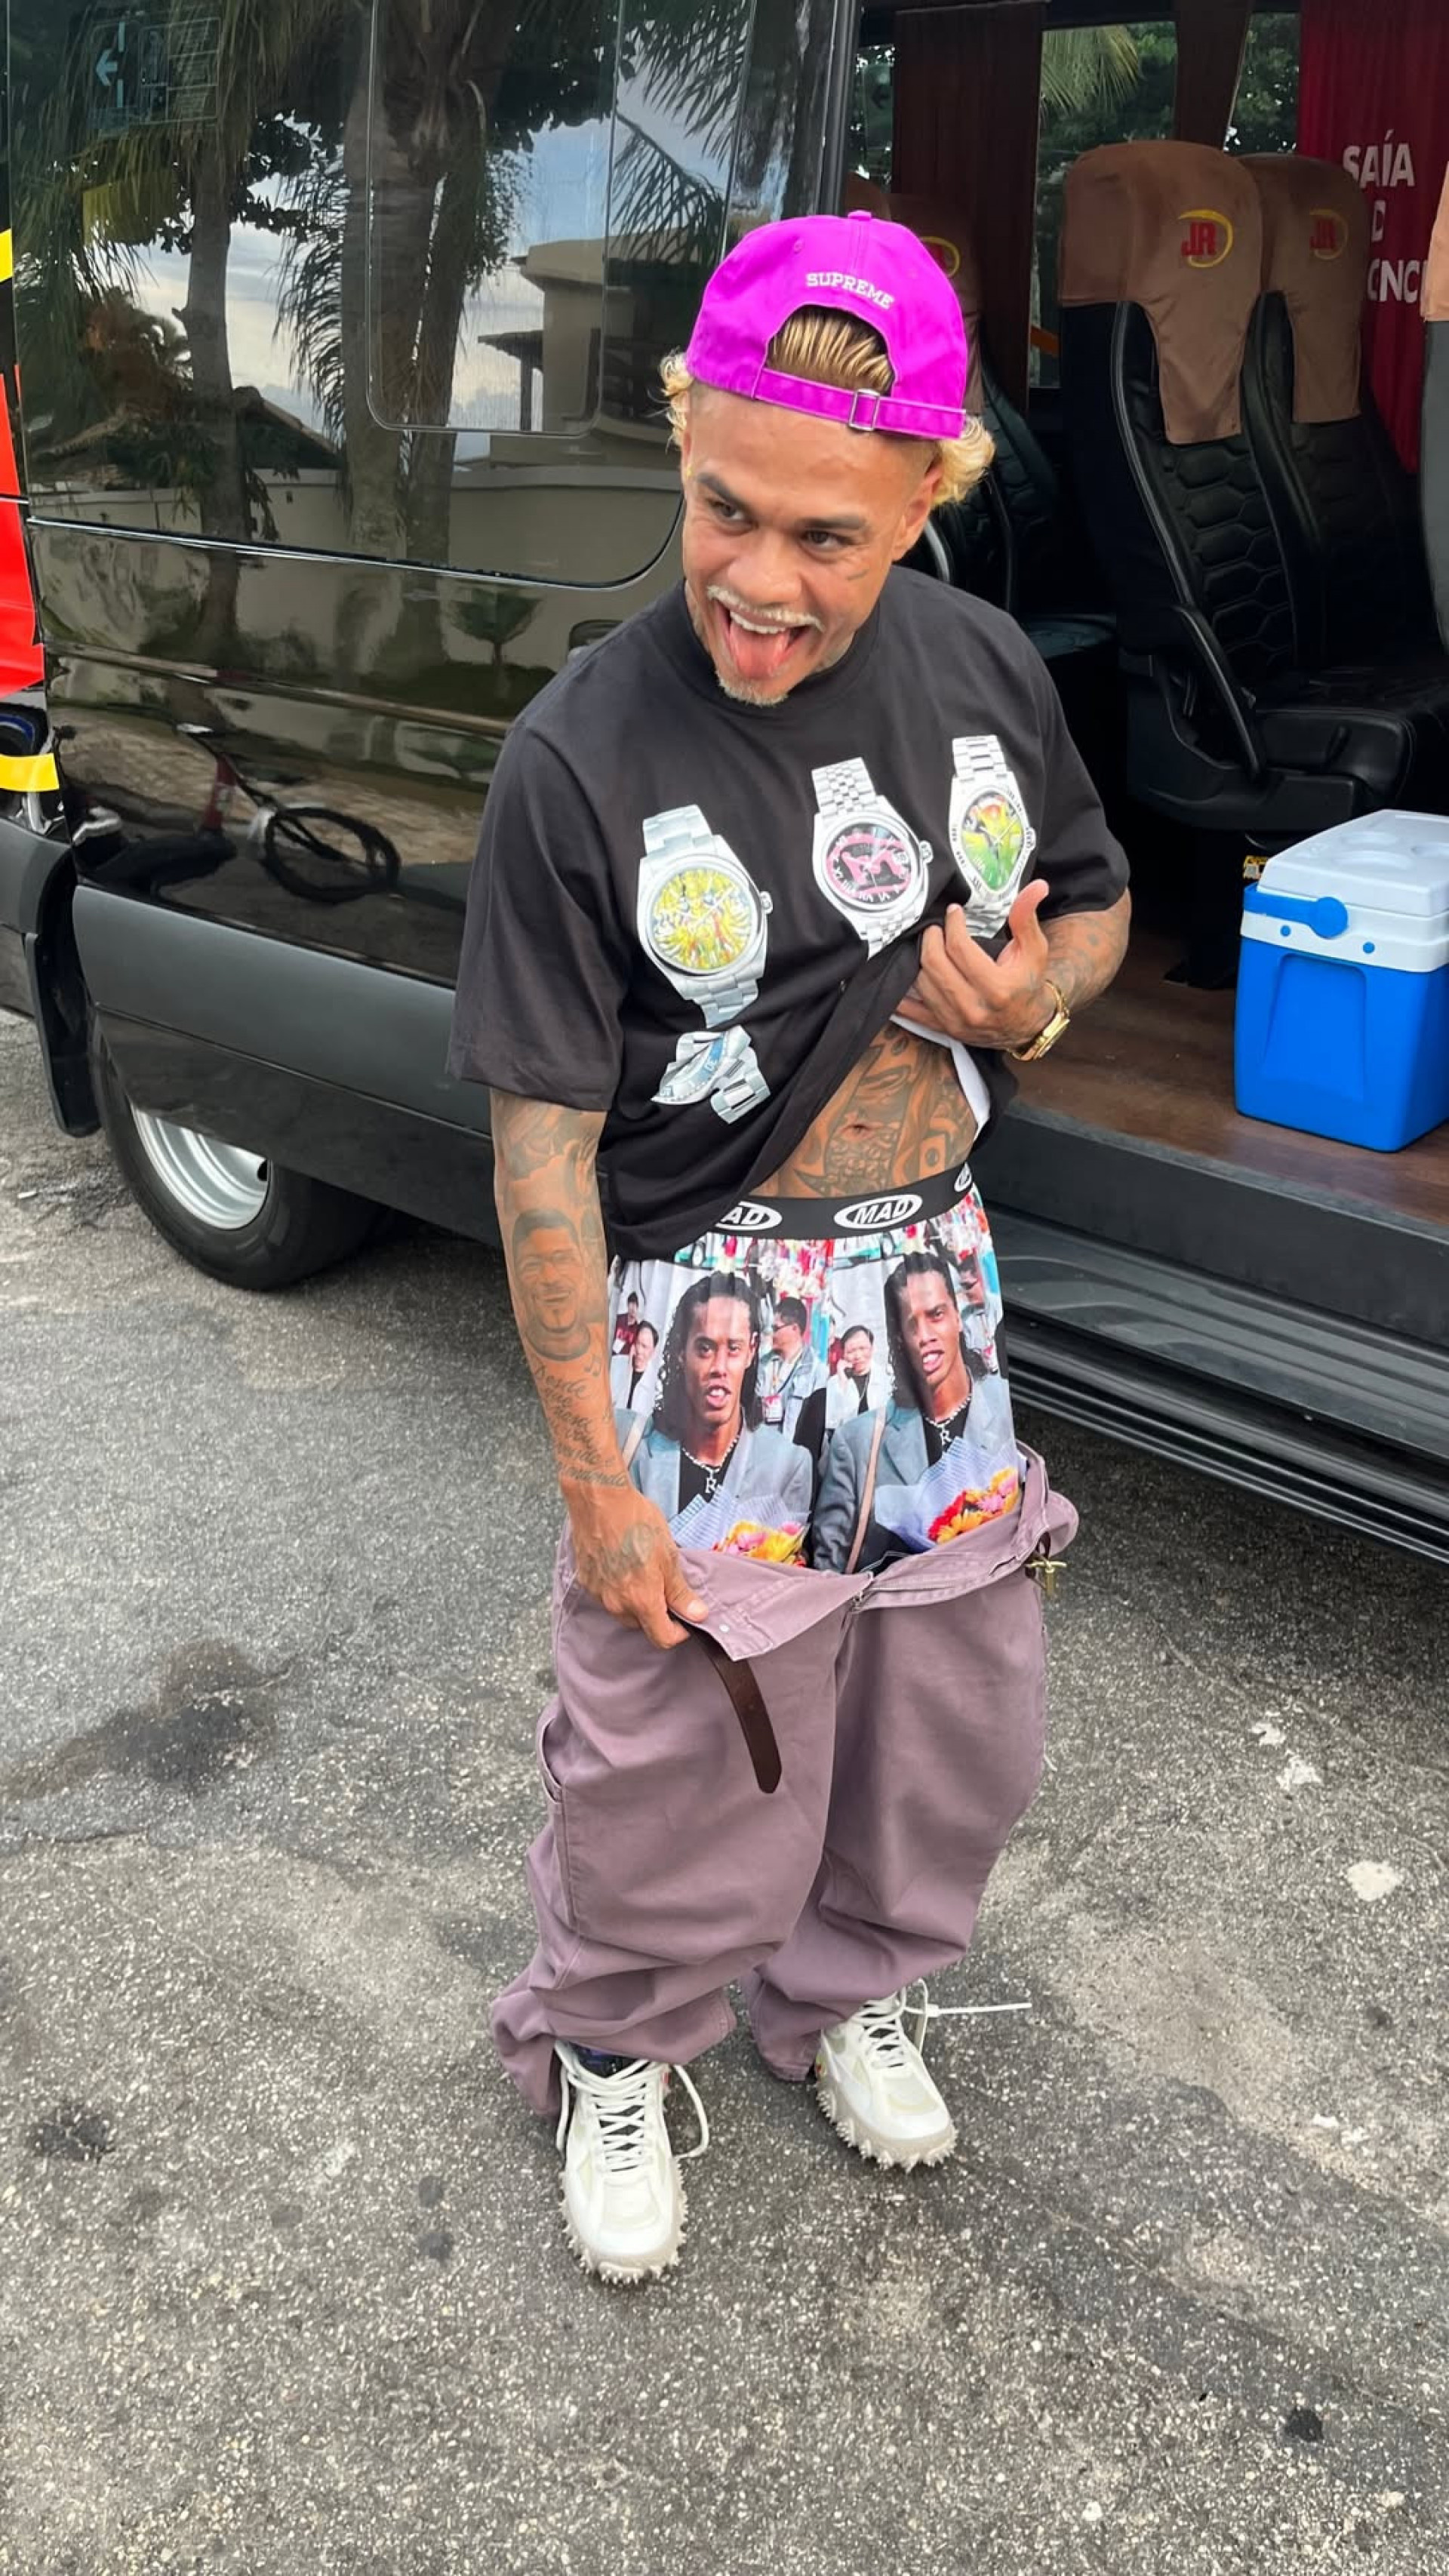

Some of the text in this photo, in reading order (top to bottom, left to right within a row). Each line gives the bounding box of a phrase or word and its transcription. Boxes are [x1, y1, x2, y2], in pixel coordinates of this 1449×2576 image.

[1180, 221, 1217, 256] JR
[806, 272, 894, 309] SUPREME
[718, 1205, 764, 1226] AD
[854, 1198, 909, 1224] MAD
